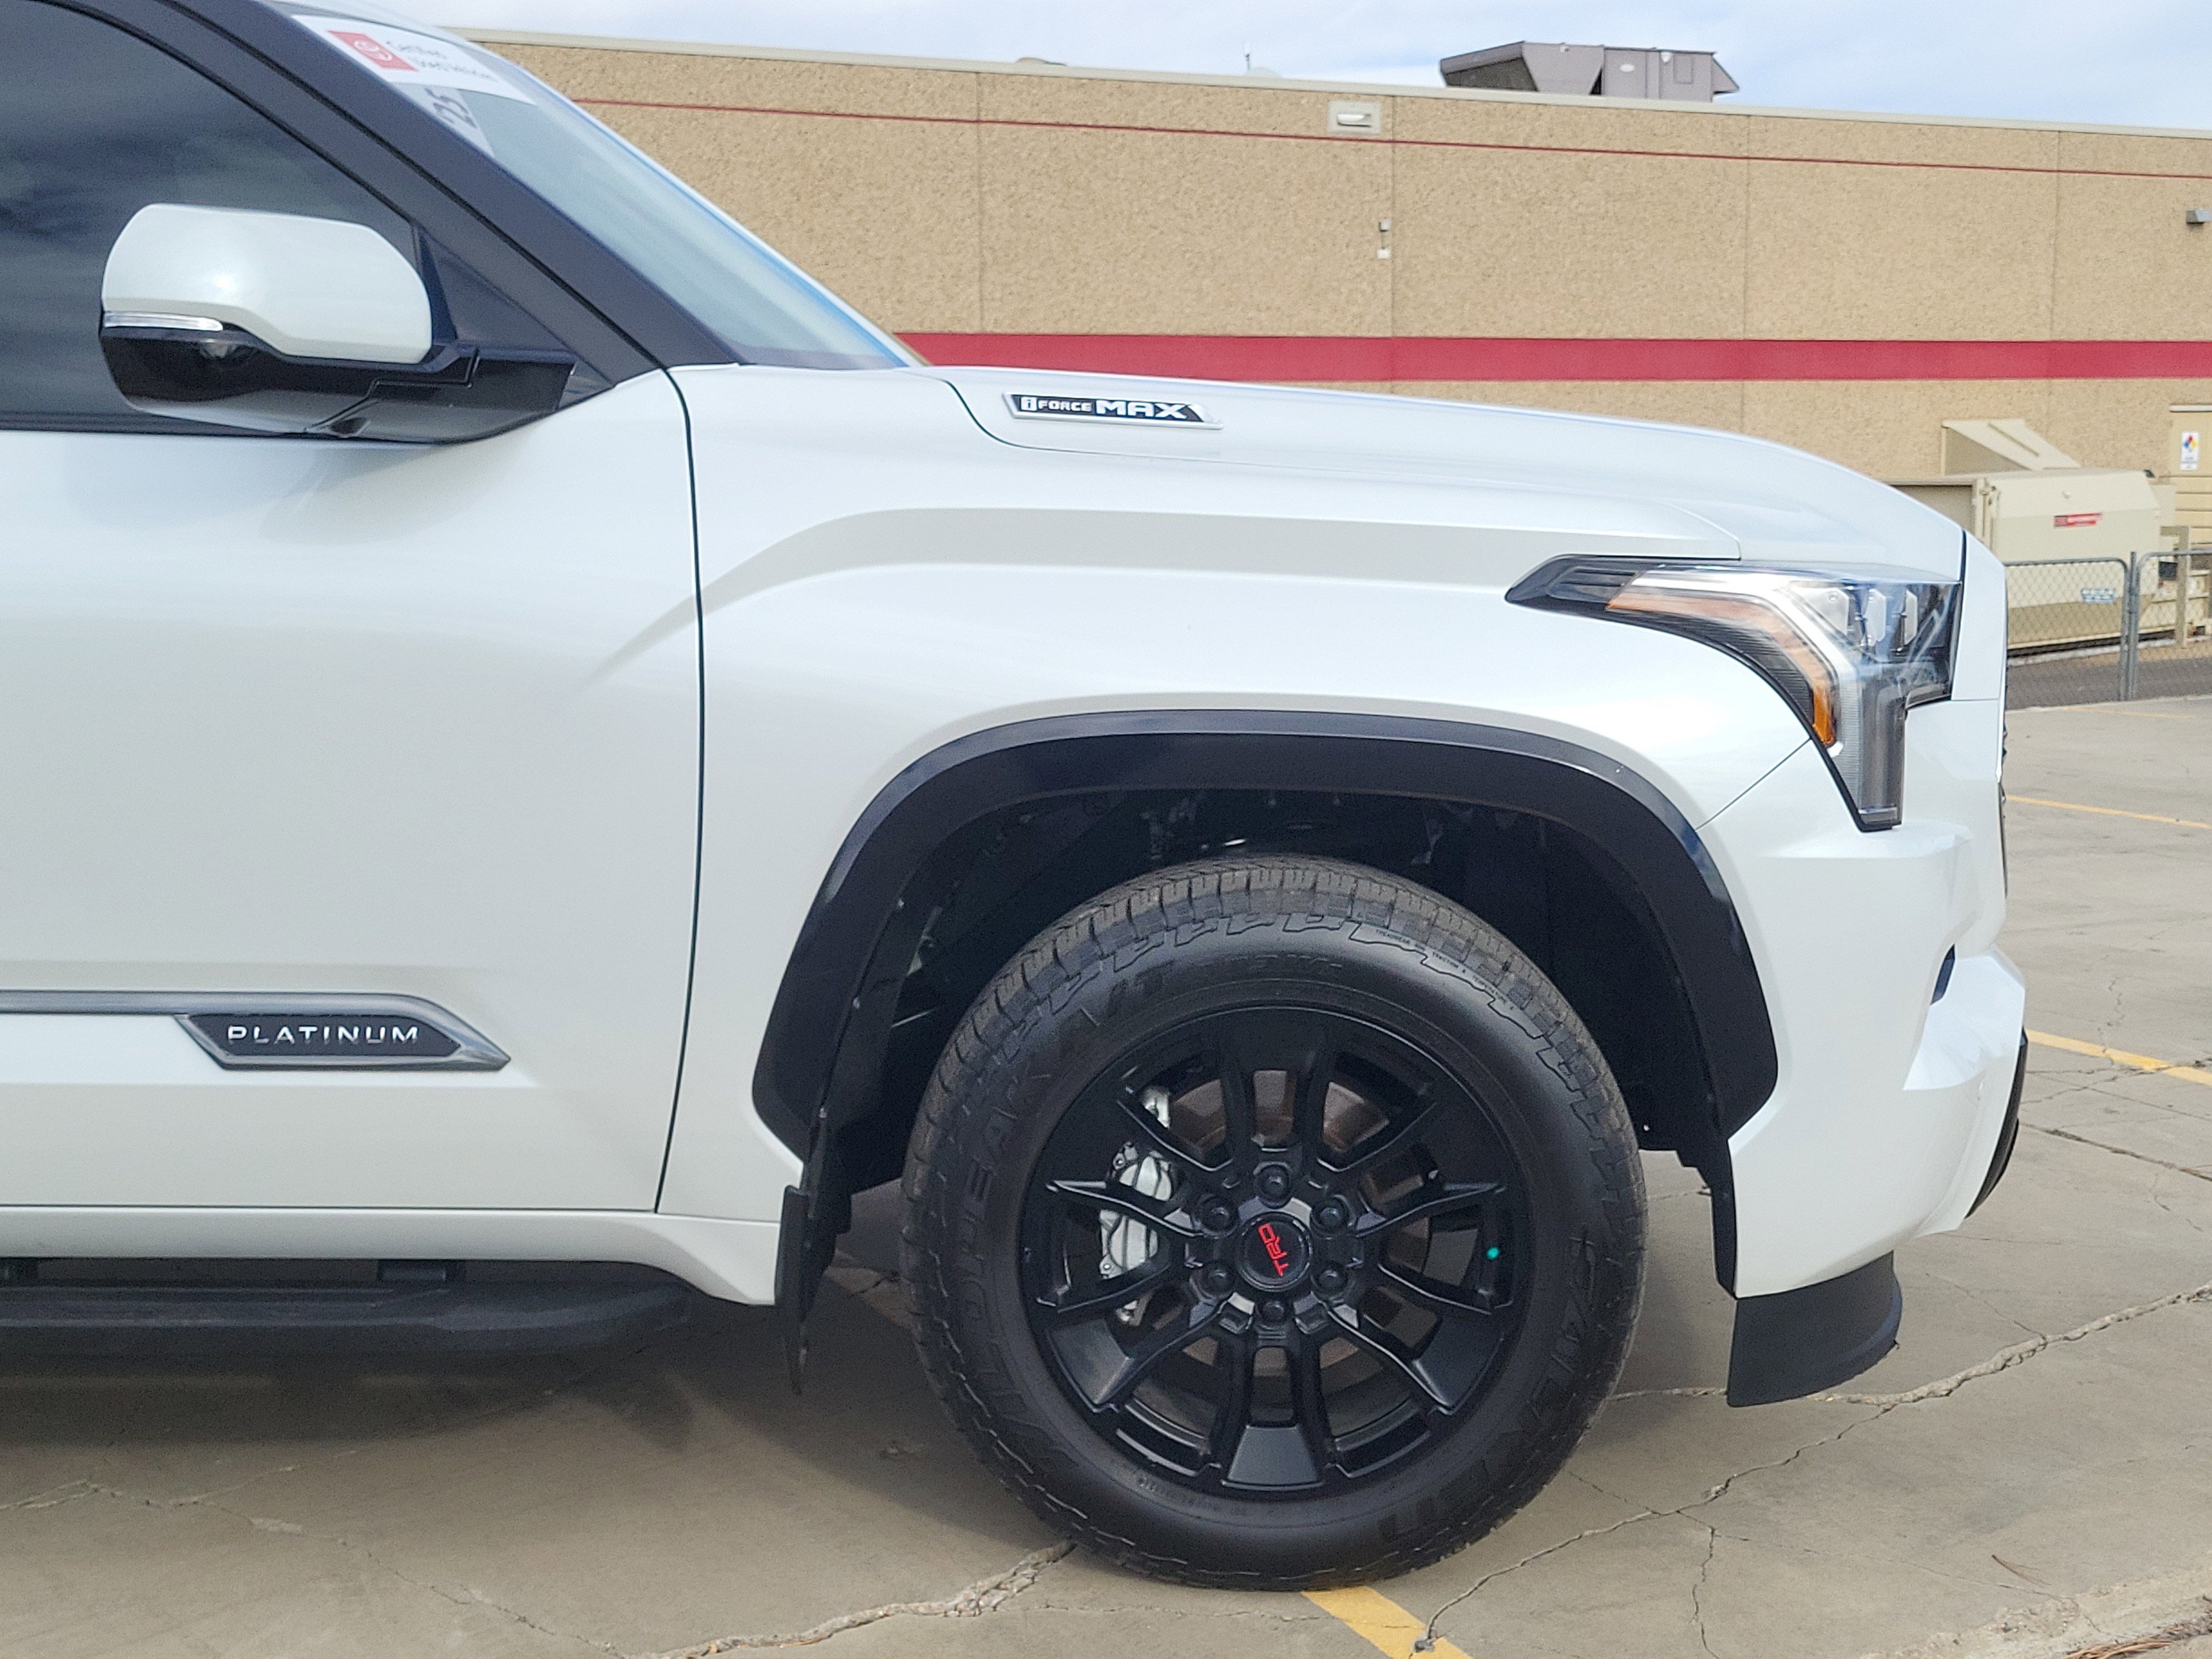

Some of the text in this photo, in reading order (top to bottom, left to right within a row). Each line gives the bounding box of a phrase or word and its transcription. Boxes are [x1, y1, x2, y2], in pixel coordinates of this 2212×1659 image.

[1096, 400, 1187, 419] MAX
[227, 1025, 419, 1044] PLATINUM
[1258, 1223, 1289, 1277] TRD
